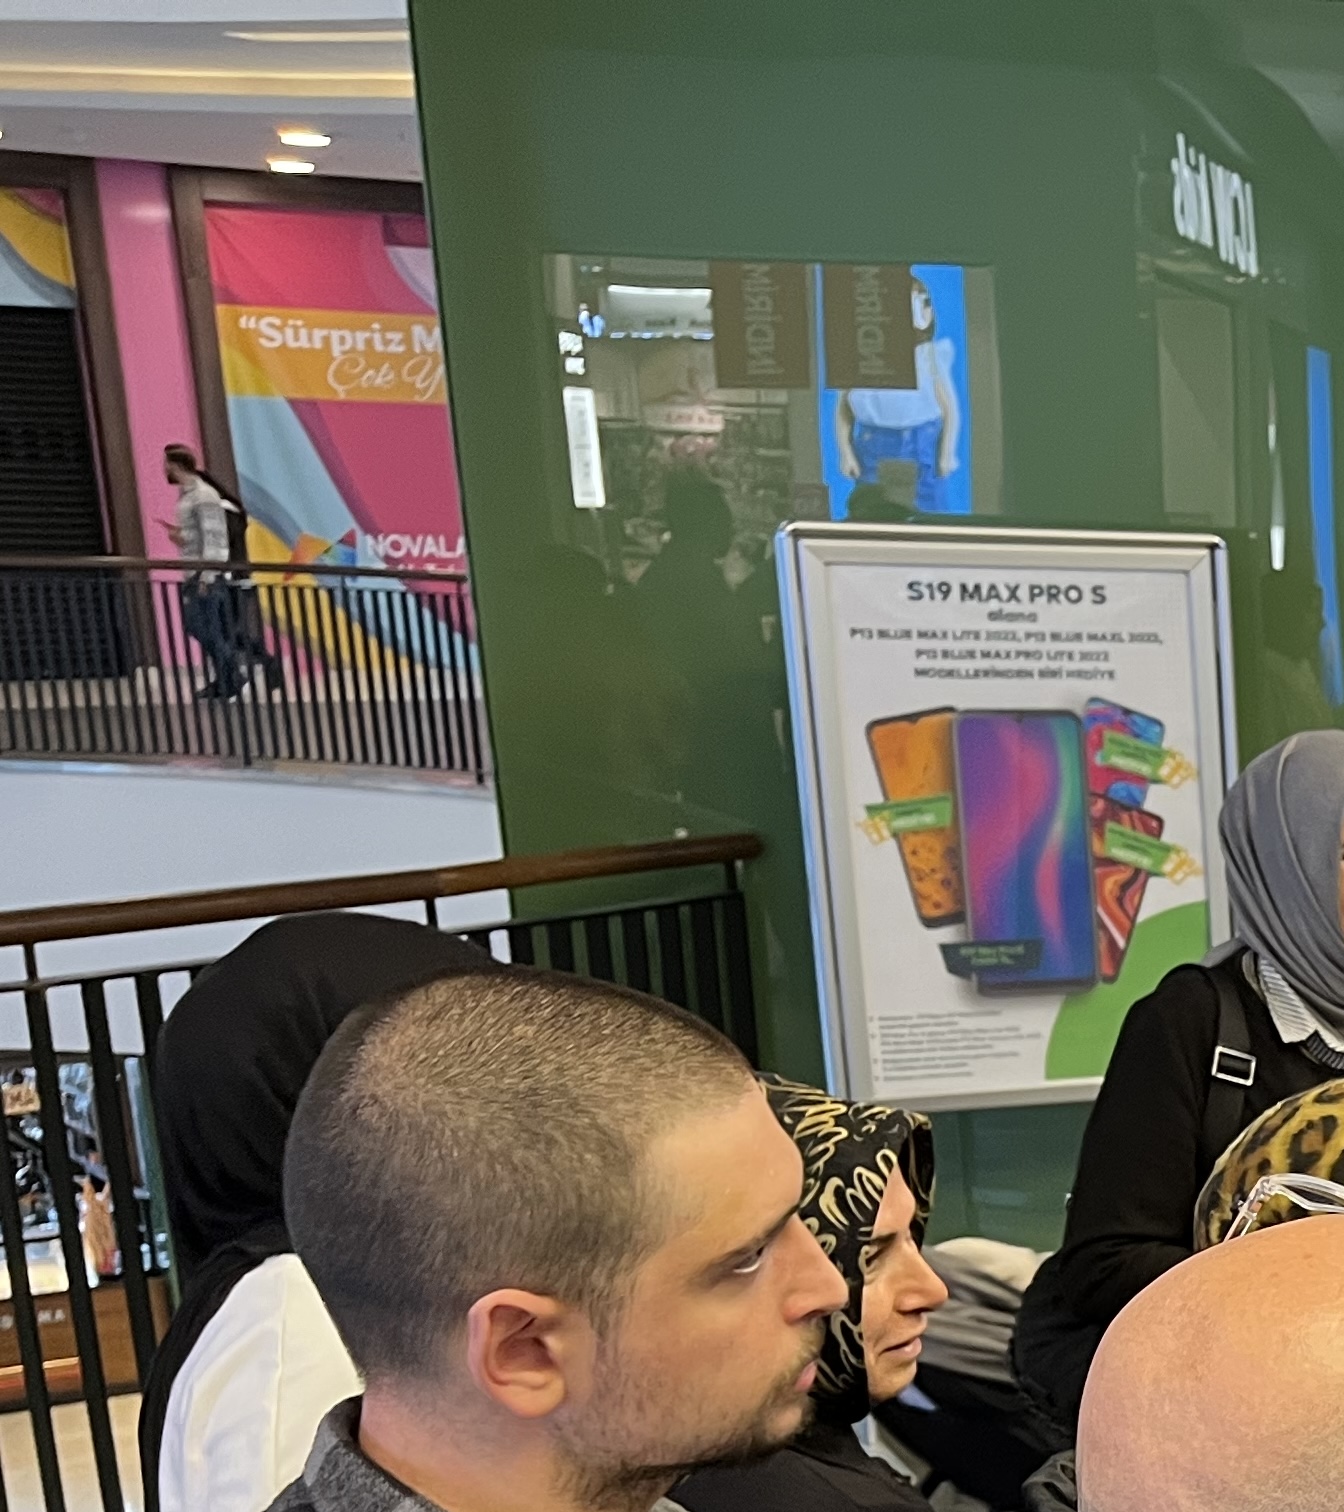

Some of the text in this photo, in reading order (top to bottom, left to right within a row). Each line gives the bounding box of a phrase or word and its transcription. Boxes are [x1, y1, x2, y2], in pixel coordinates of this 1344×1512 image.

[326, 353, 397, 400] Çok
[906, 580, 1108, 606] S19 MAX PRO S
[876, 628, 913, 641] BLUE
[916, 629, 948, 641] MAX
[1049, 631, 1084, 644] BLUE
[940, 649, 977, 661] BLUE
[979, 650, 1012, 662] MAX
[1013, 650, 1044, 662] PRO
